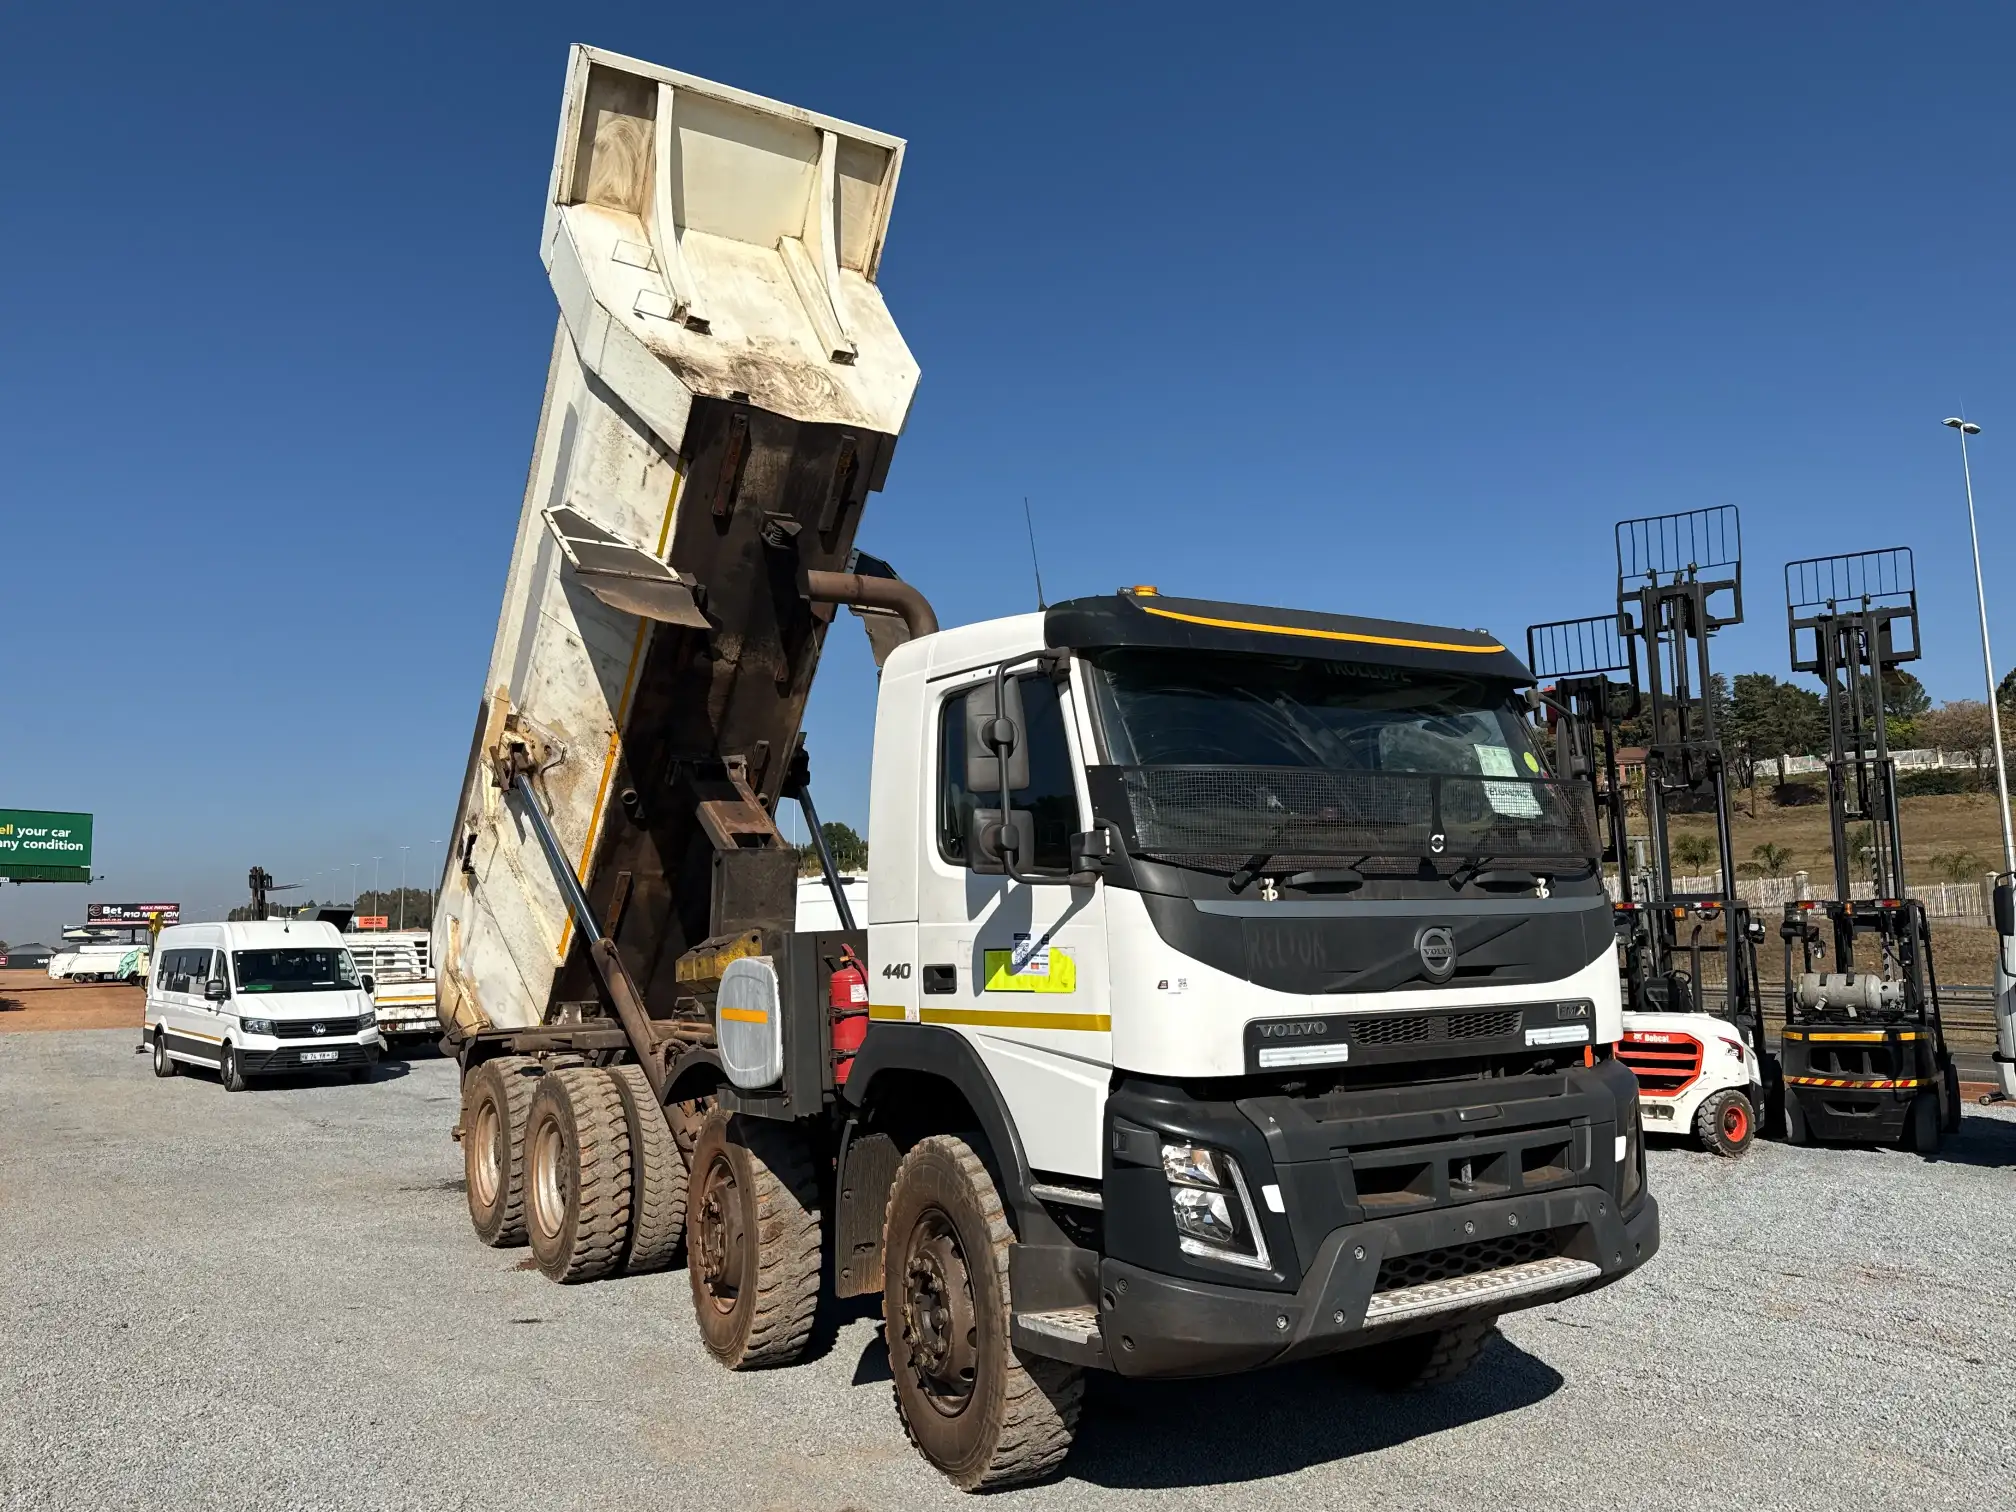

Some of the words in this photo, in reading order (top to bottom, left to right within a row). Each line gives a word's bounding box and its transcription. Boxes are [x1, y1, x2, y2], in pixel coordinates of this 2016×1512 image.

[16, 827, 48, 838] your
[51, 829, 71, 838] car
[23, 839, 84, 851] condition
[1422, 947, 1453, 956] VOLVO
[882, 963, 912, 980] 440
[1255, 1021, 1328, 1038] VOLVO
[1644, 1033, 1669, 1042] Bobcat
